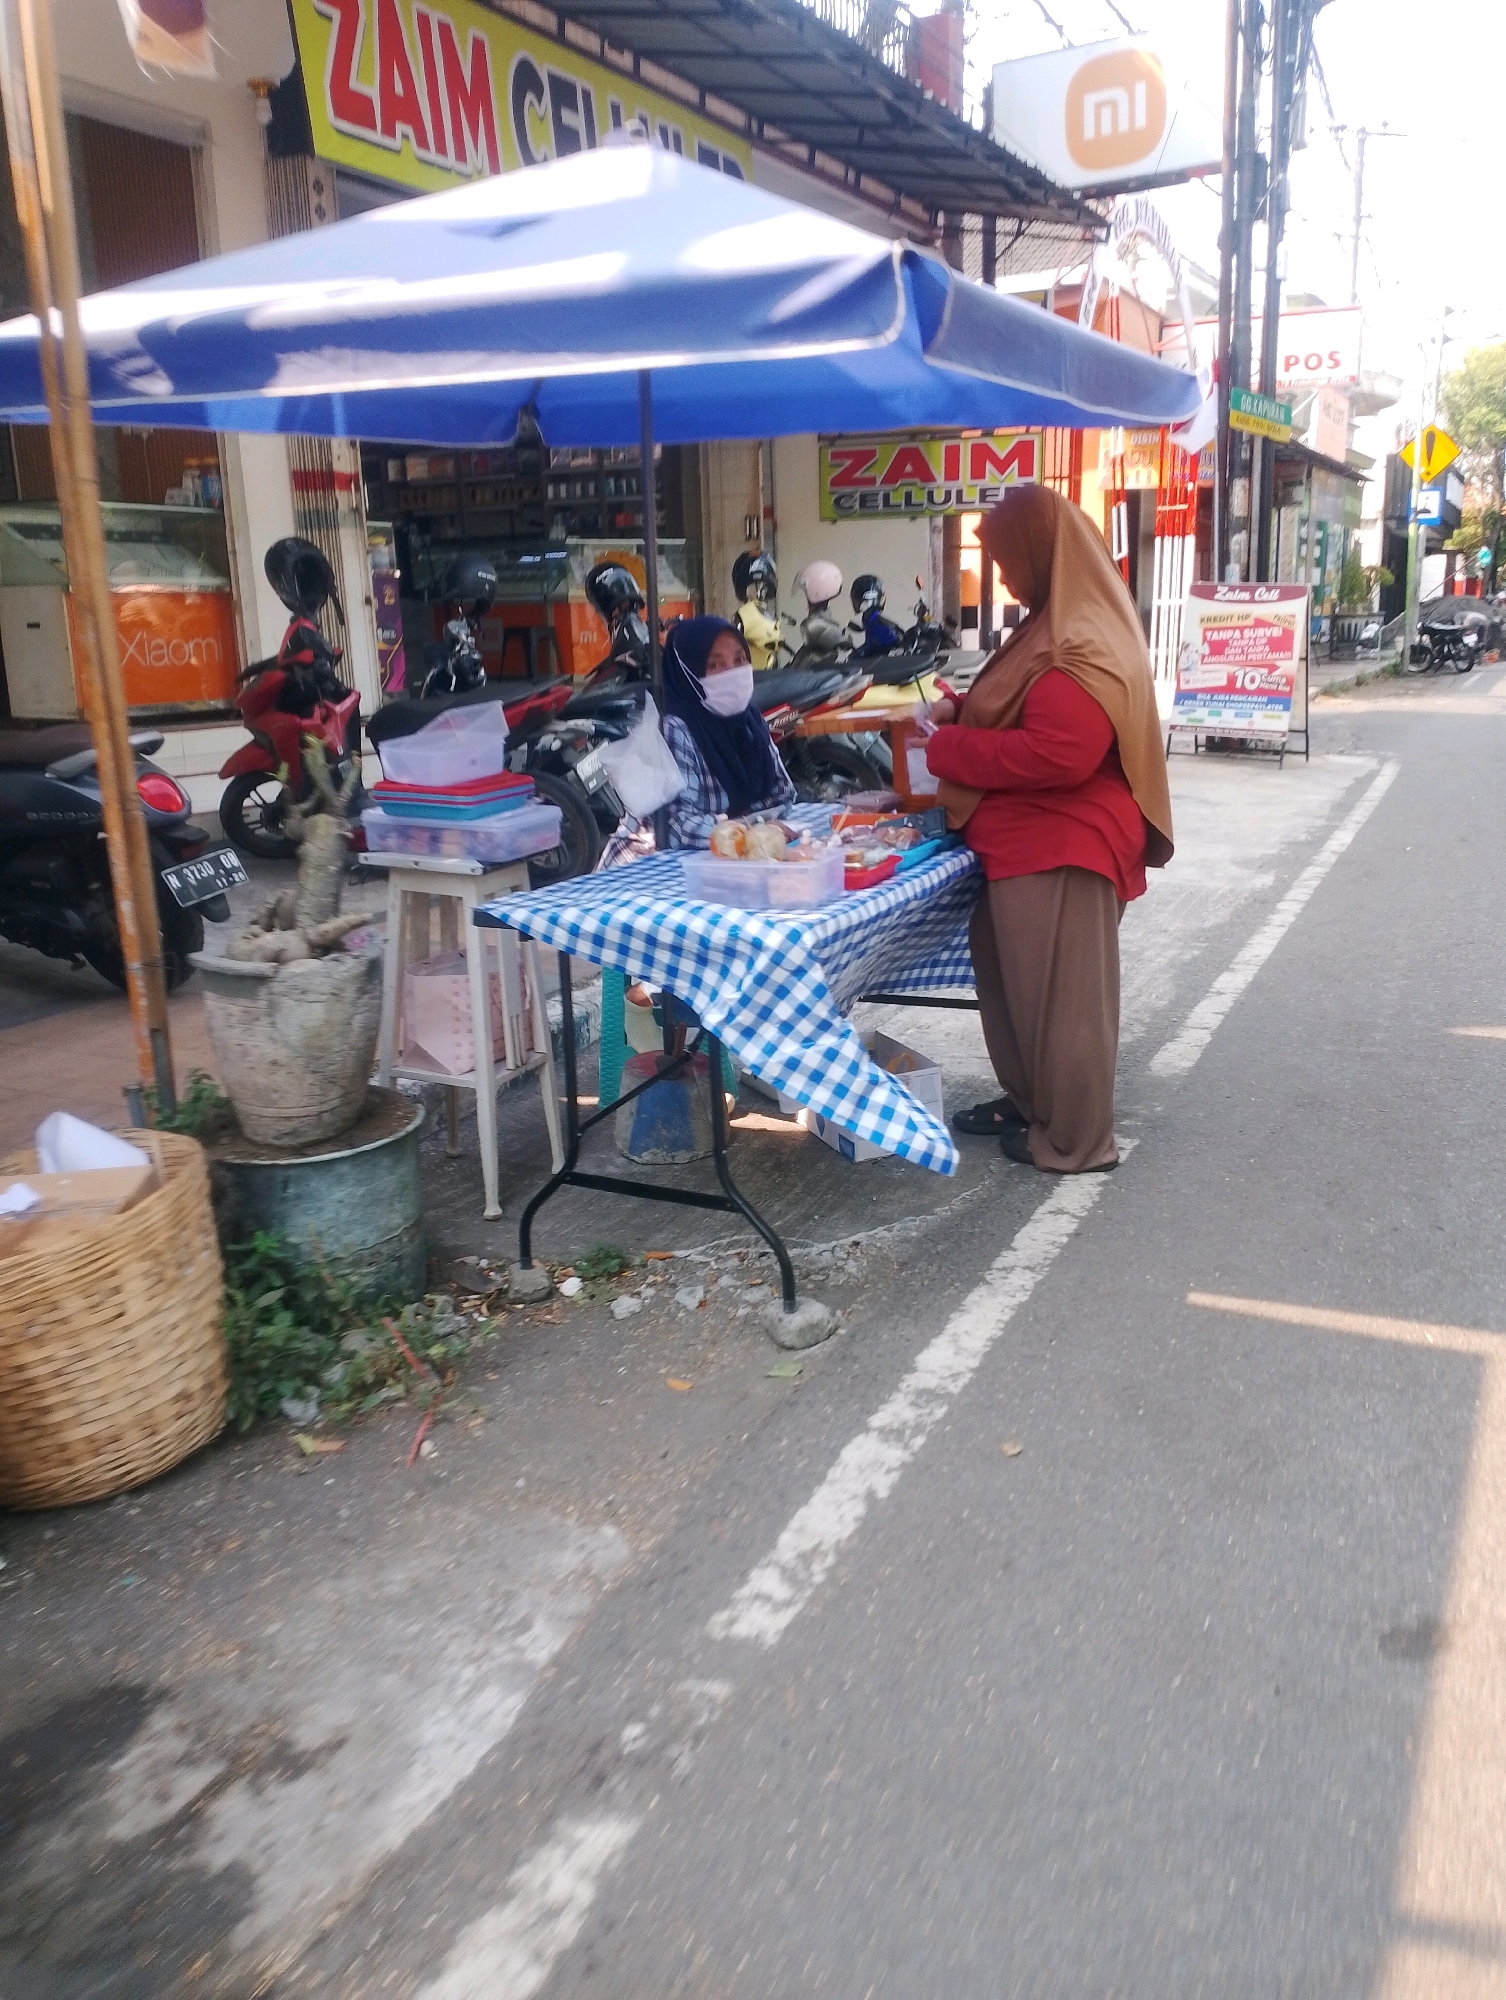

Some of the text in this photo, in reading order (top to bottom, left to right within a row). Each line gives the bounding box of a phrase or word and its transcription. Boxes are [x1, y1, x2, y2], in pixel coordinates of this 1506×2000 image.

[312, 0, 501, 175] ZAIM
[1283, 350, 1342, 373] POS
[829, 437, 1037, 491] ZAIM
[831, 485, 1006, 515] CELLULE
[1254, 586, 1280, 601] Cell
[117, 629, 223, 667] Xiaomi
[1205, 629, 1242, 641] TANPA
[1234, 667, 1261, 691] 10
[167, 873, 182, 890] N
[183, 861, 215, 886] 3730
